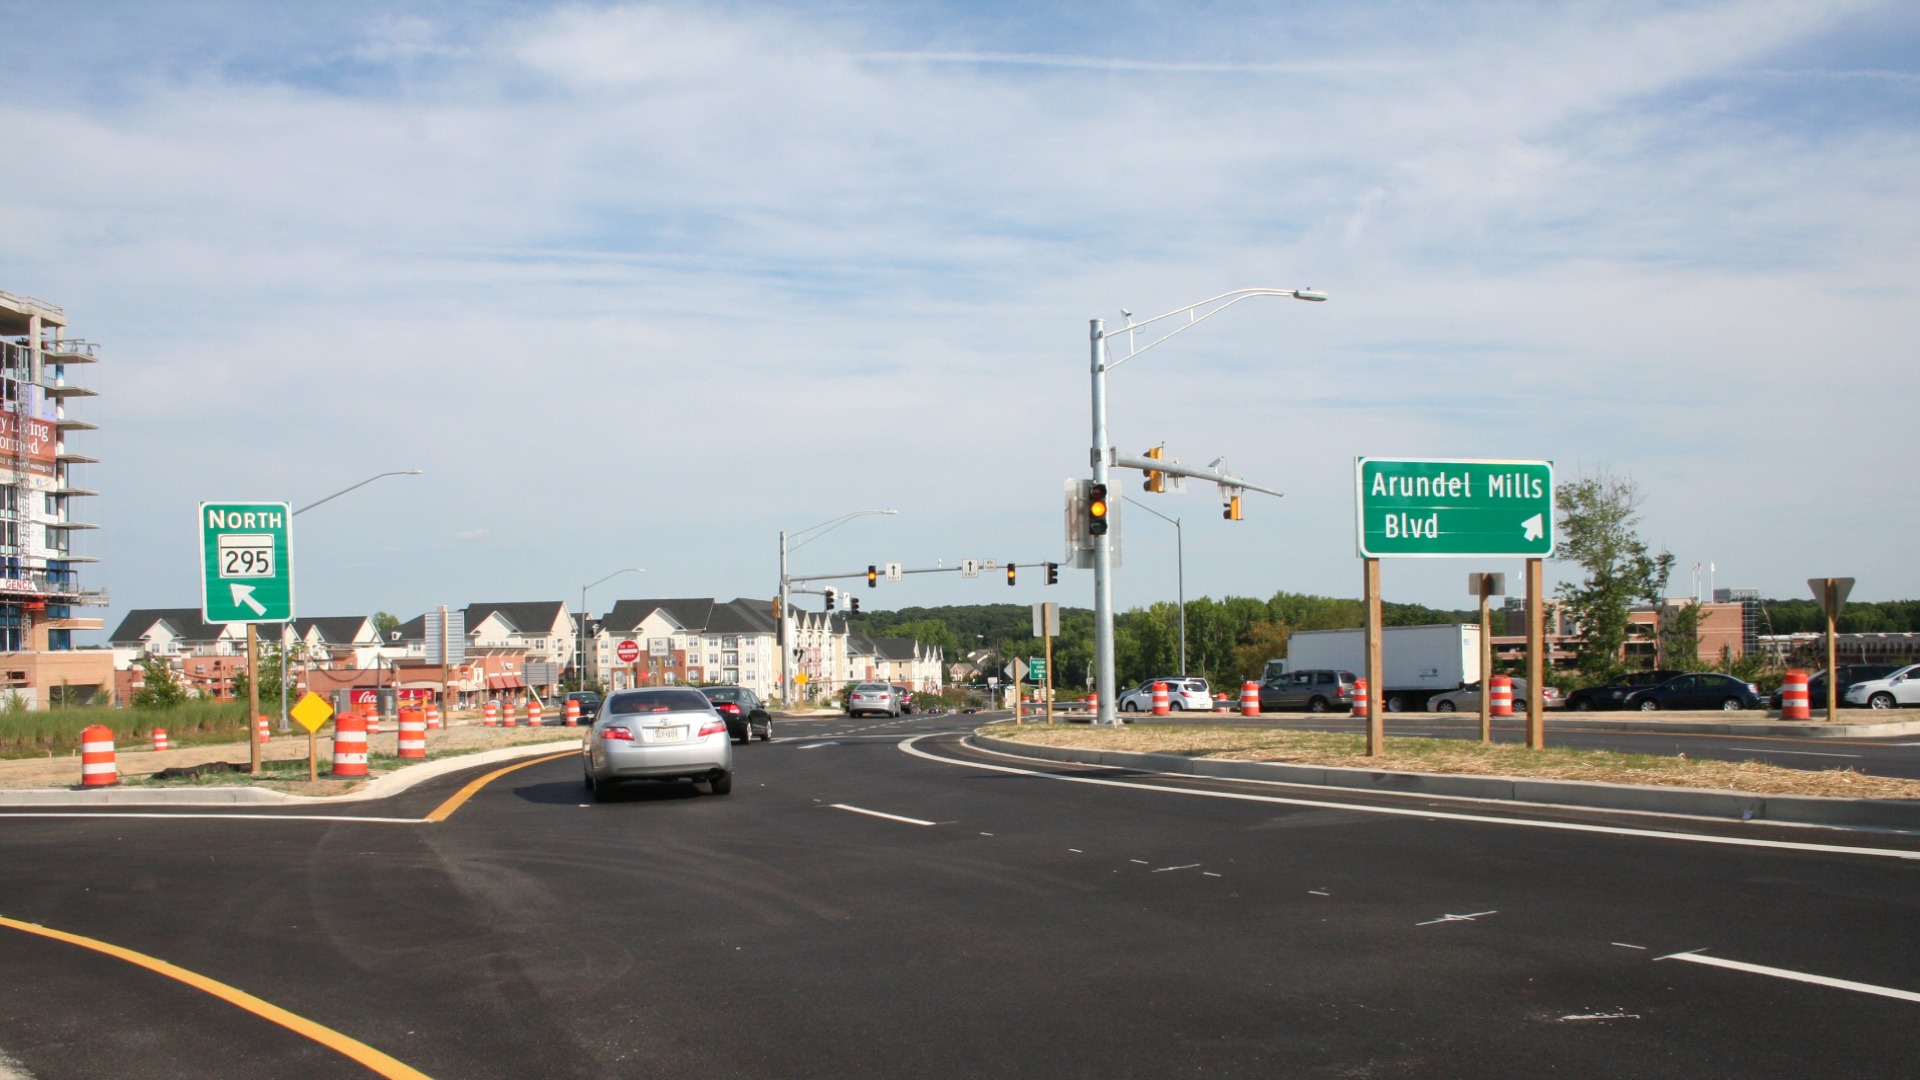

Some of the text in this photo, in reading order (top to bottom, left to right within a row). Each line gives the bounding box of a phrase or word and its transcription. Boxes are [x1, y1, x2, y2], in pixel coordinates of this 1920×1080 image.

[11, 416, 49, 442] Liing
[1371, 472, 1543, 499] Arundel Mills
[208, 509, 282, 529] NORTH
[1385, 512, 1438, 539] Blvd
[225, 550, 270, 574] 295
